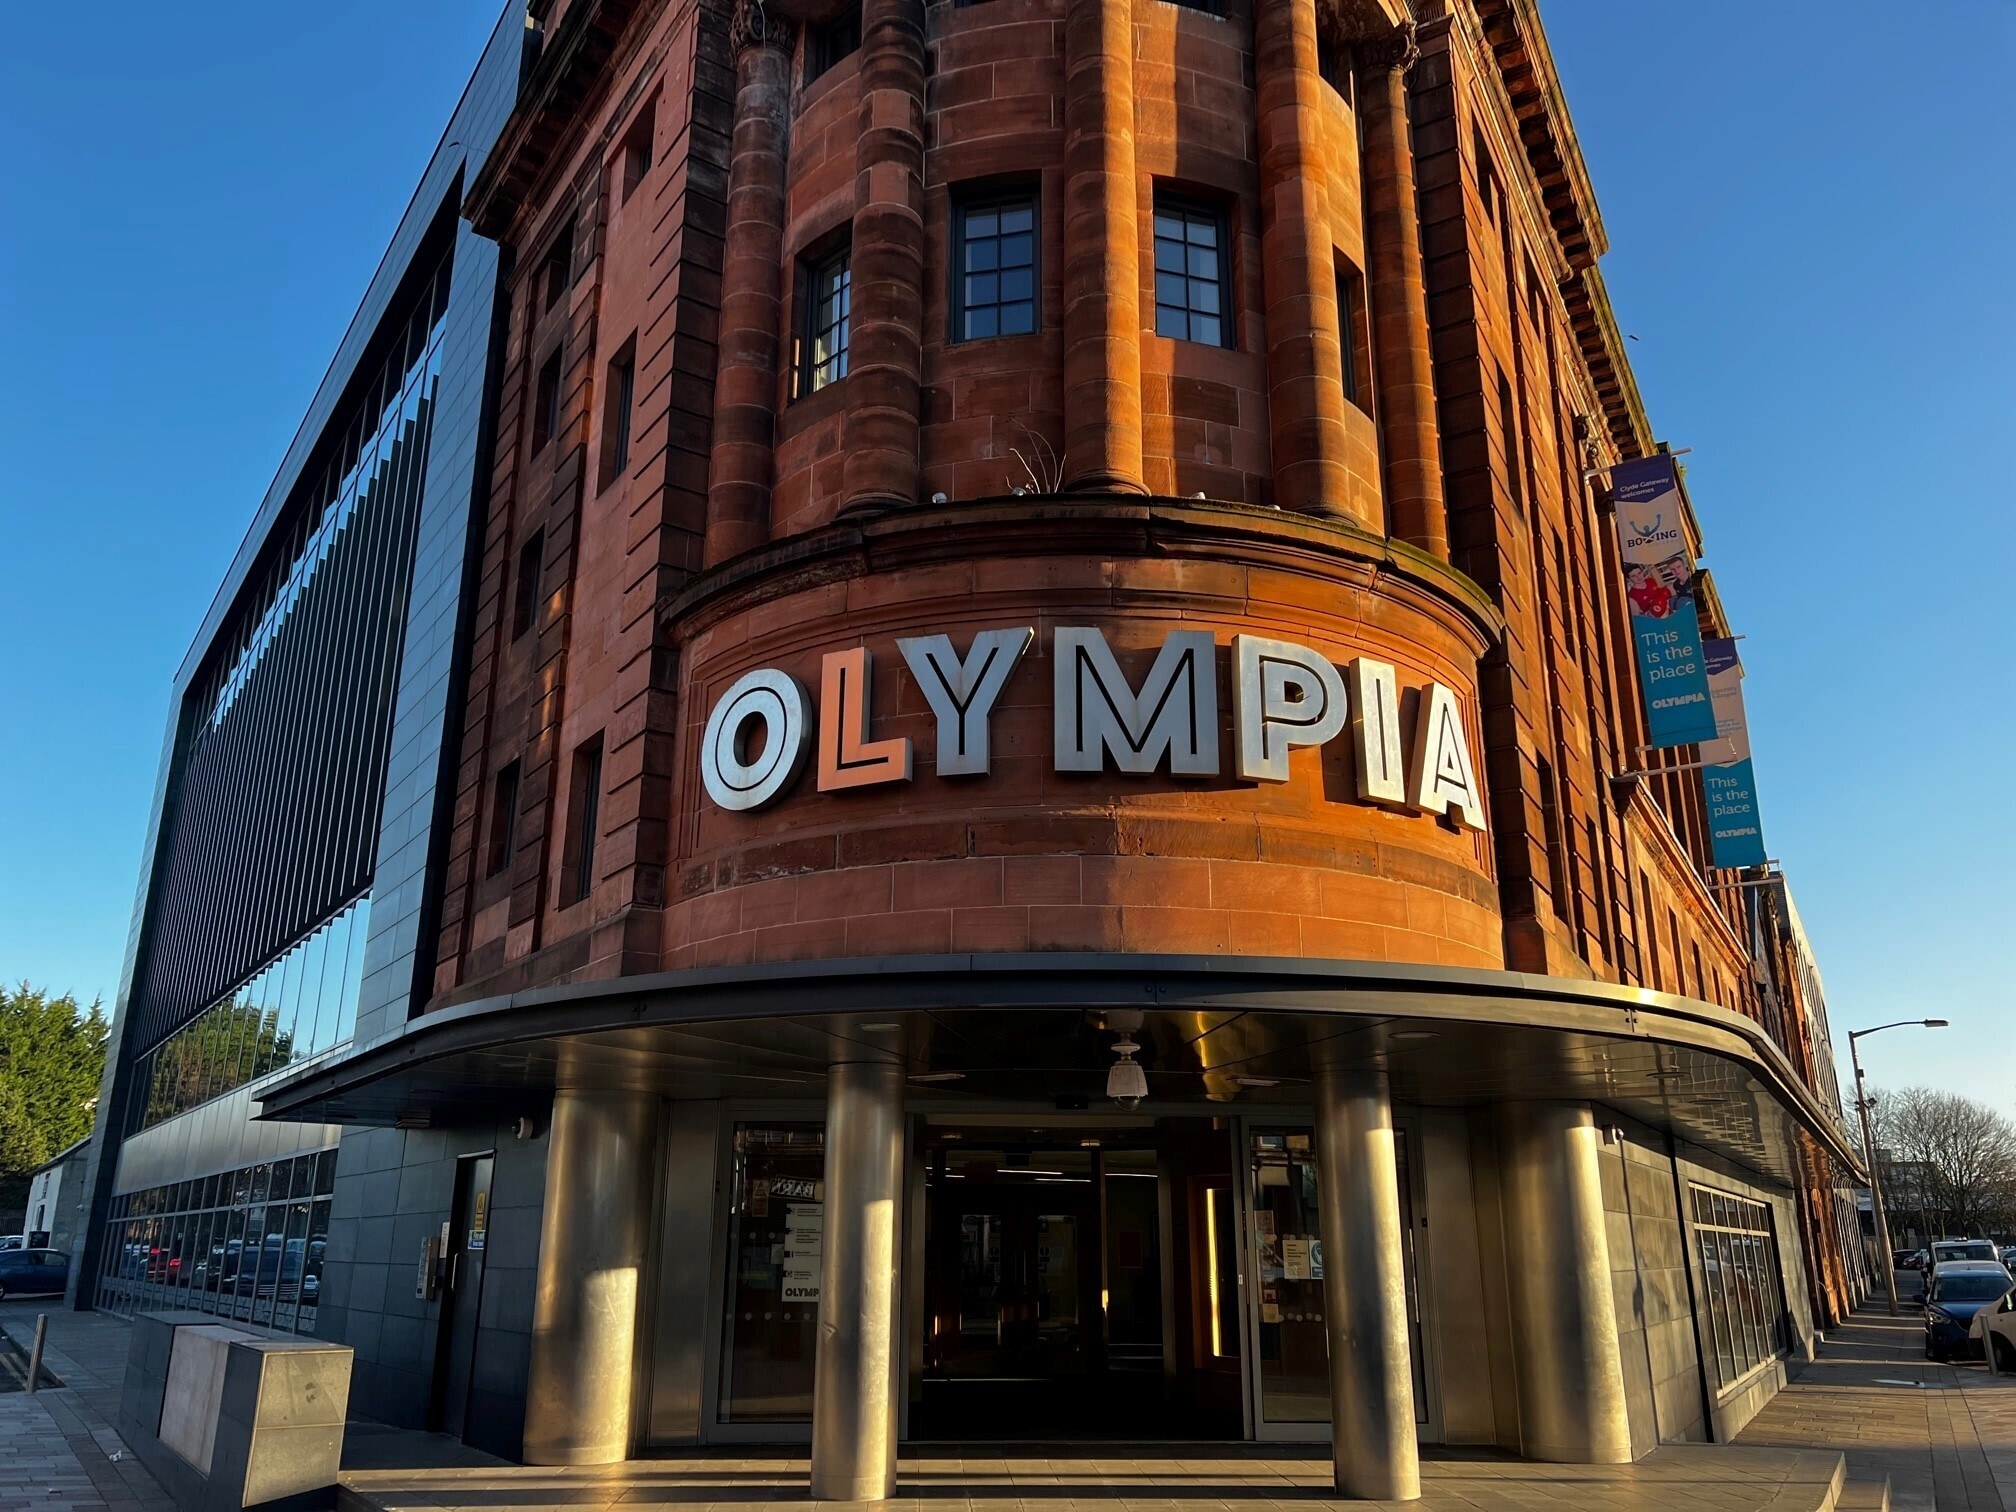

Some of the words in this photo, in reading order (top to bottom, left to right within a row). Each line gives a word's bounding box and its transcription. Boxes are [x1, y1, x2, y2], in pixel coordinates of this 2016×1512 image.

[1619, 484, 1639, 492] Clyde
[1639, 477, 1669, 488] Gateway
[1620, 487, 1655, 499] welcomes
[1641, 630, 1679, 646] This
[1646, 651, 1660, 663] is
[1665, 645, 1693, 660] the
[1648, 662, 1696, 683] place
[1652, 692, 1706, 709] OLYMPIA
[701, 625, 1488, 833] OLYMPIA
[1708, 778, 1738, 789] This
[1712, 792, 1723, 802] is
[1726, 790, 1749, 801] the
[1713, 804, 1751, 818] place
[1715, 827, 1757, 838] OLYMPIA
